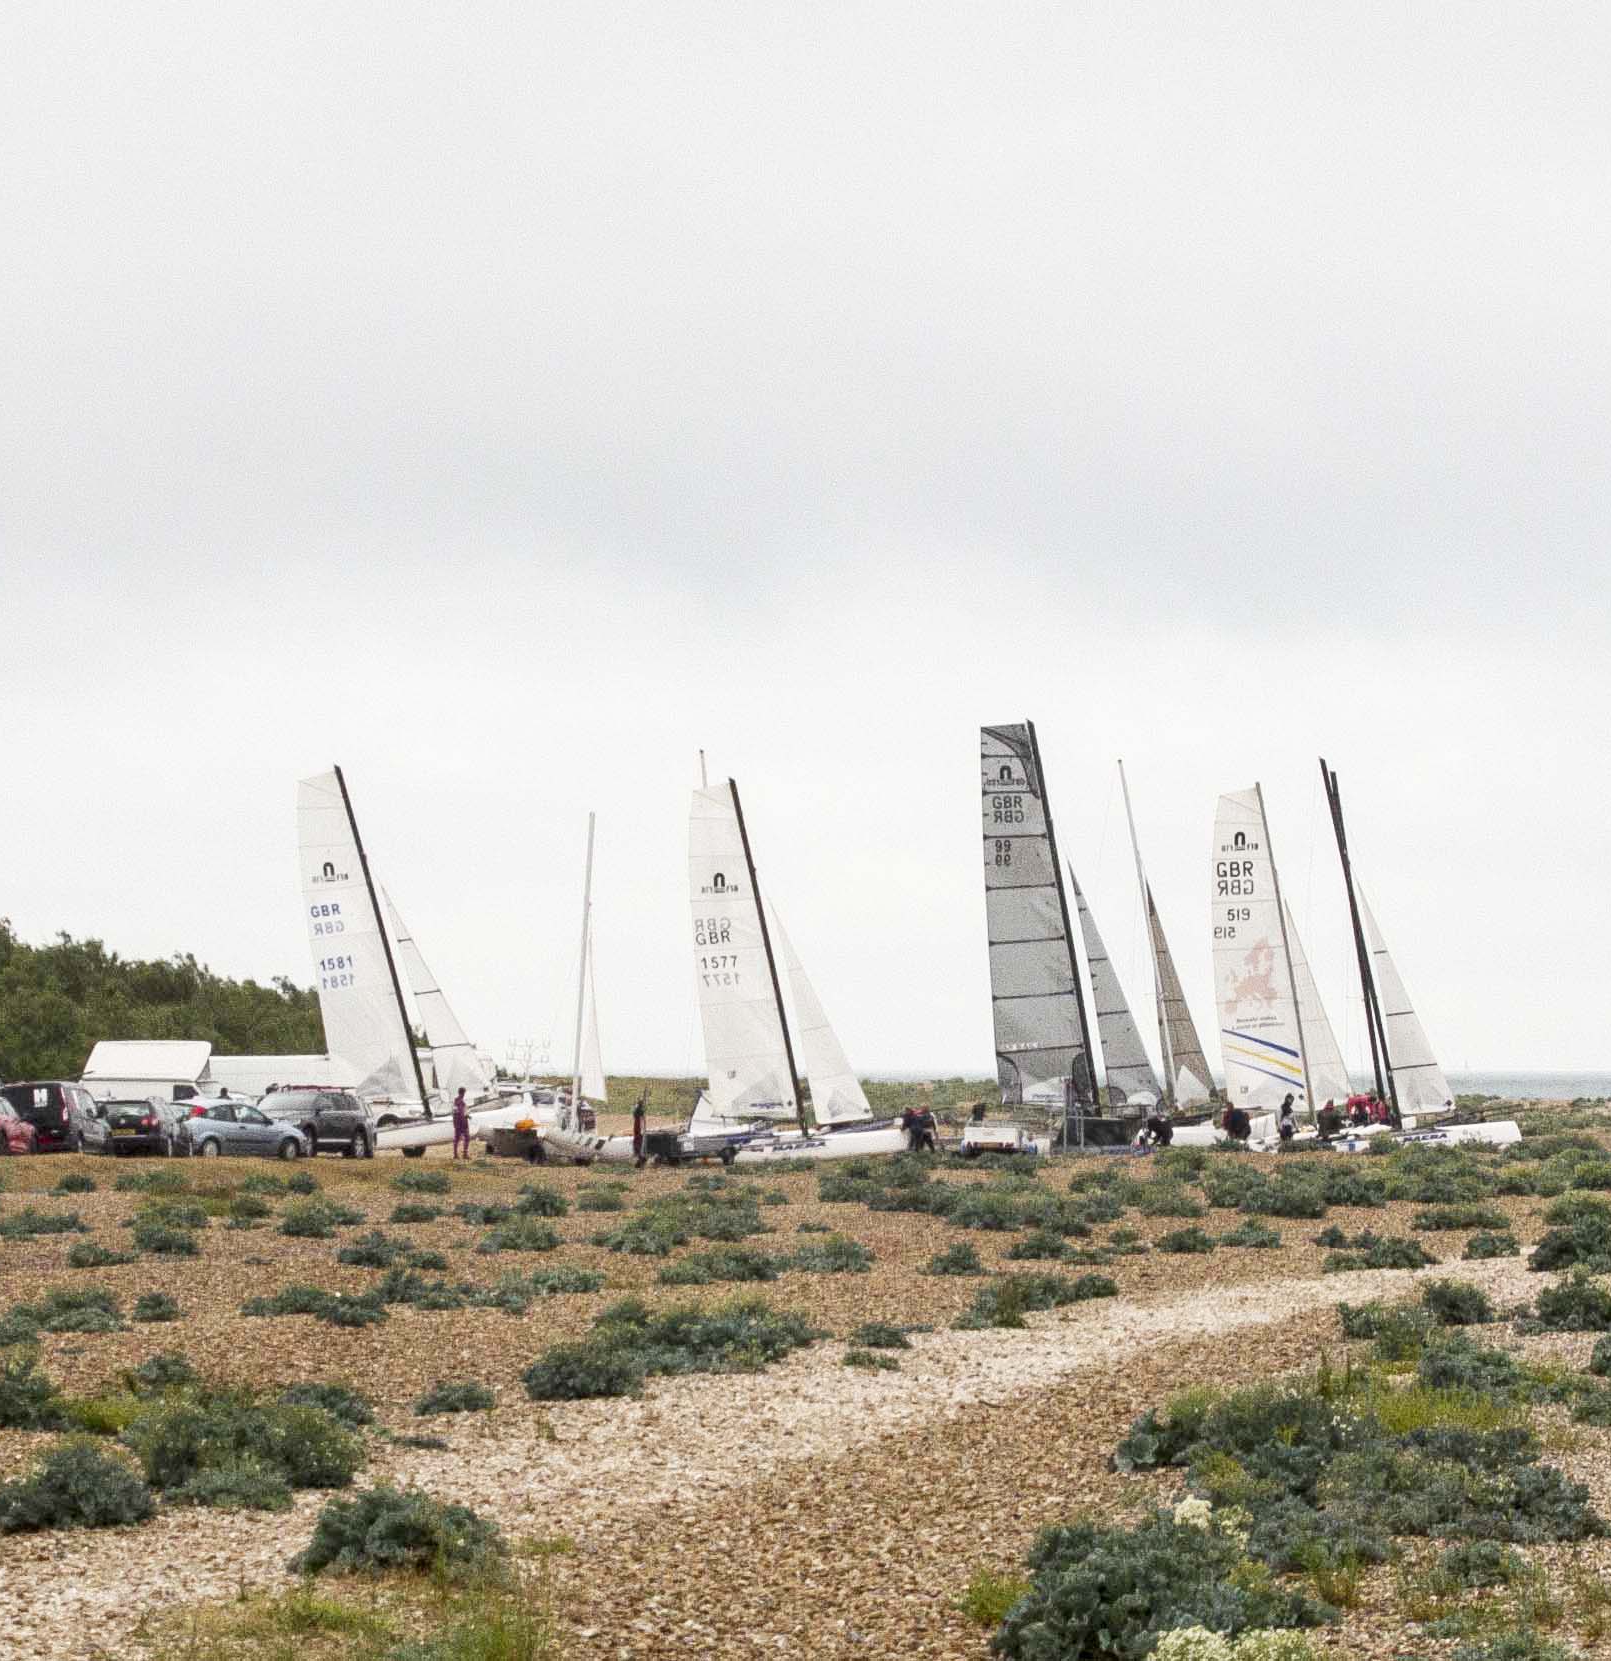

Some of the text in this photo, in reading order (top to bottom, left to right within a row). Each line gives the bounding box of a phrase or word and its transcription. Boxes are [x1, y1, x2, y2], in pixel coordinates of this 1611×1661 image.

[992, 796, 1023, 809] GBR
[1216, 861, 1254, 877] GBR
[310, 903, 341, 918] GBR
[1227, 908, 1251, 921] 519
[695, 929, 731, 945] GBR
[319, 955, 353, 971] 1581
[701, 955, 738, 969] 1577
